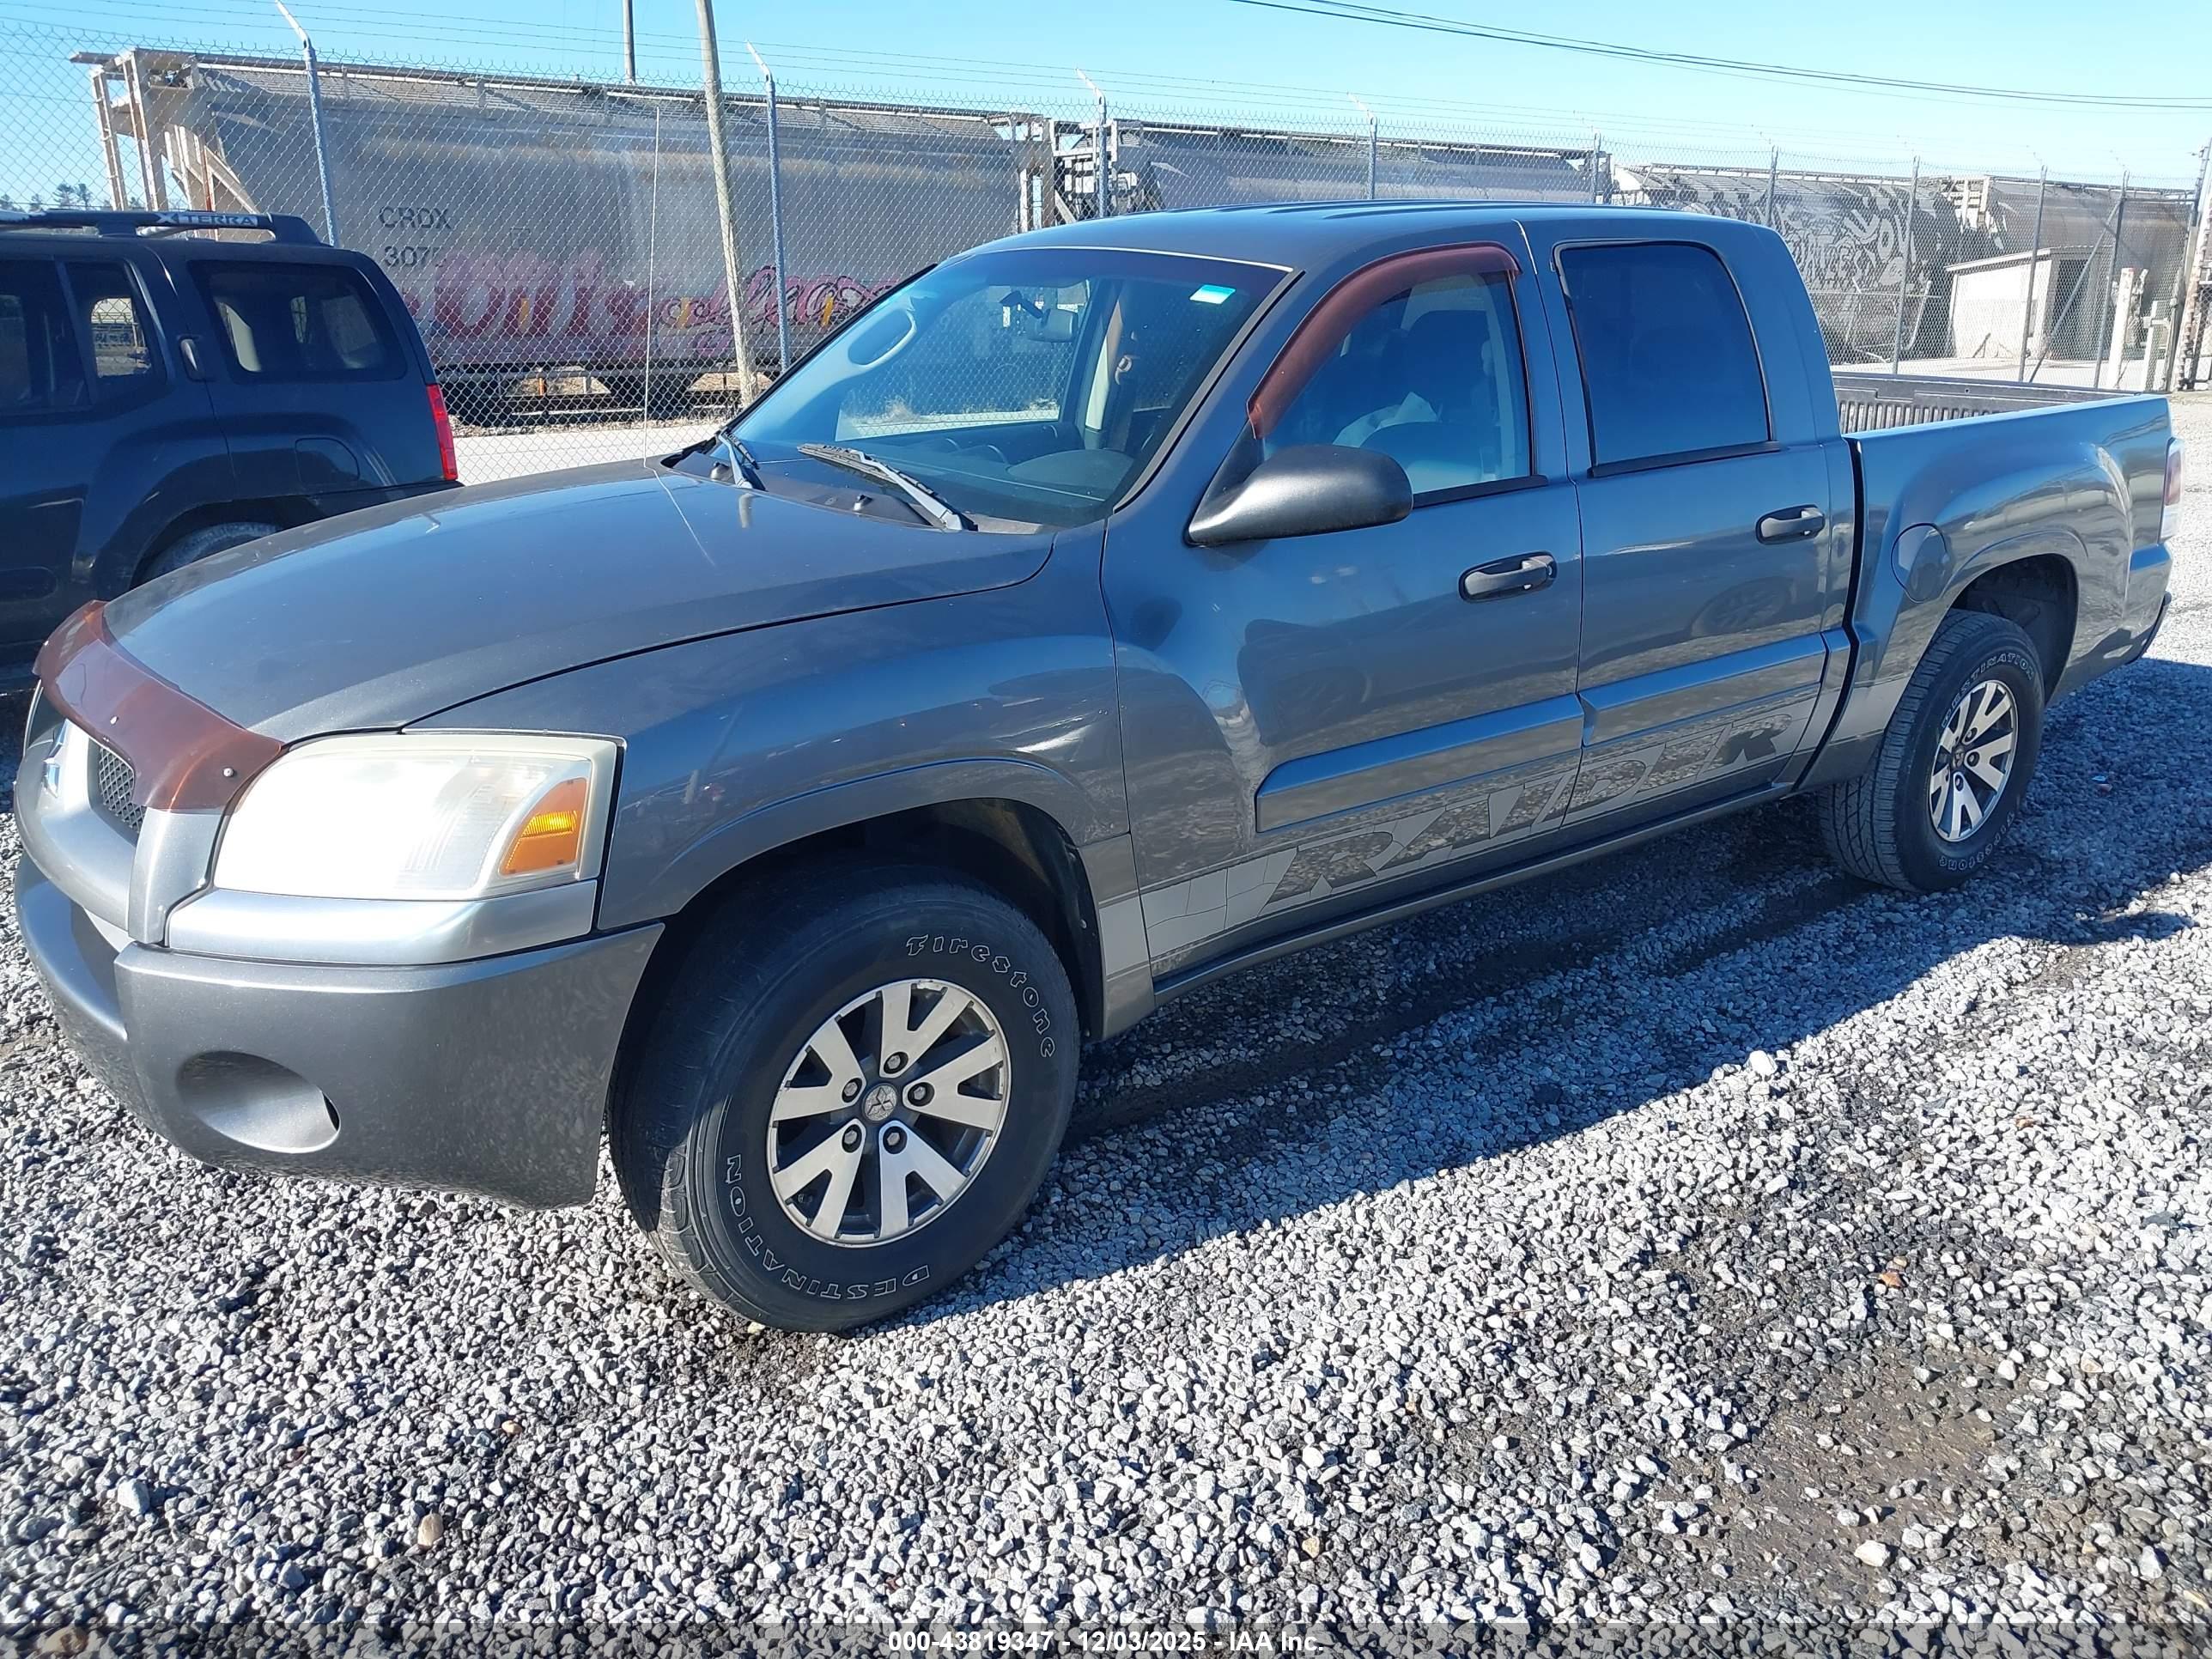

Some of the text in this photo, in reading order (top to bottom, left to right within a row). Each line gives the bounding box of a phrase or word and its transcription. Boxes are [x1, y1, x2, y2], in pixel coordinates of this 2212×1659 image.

[155, 214, 258, 227] XTERRA
[379, 206, 452, 229] CRDX
[906, 934, 1055, 1058] Firestone
[725, 1153, 931, 1300] DESTINATION
